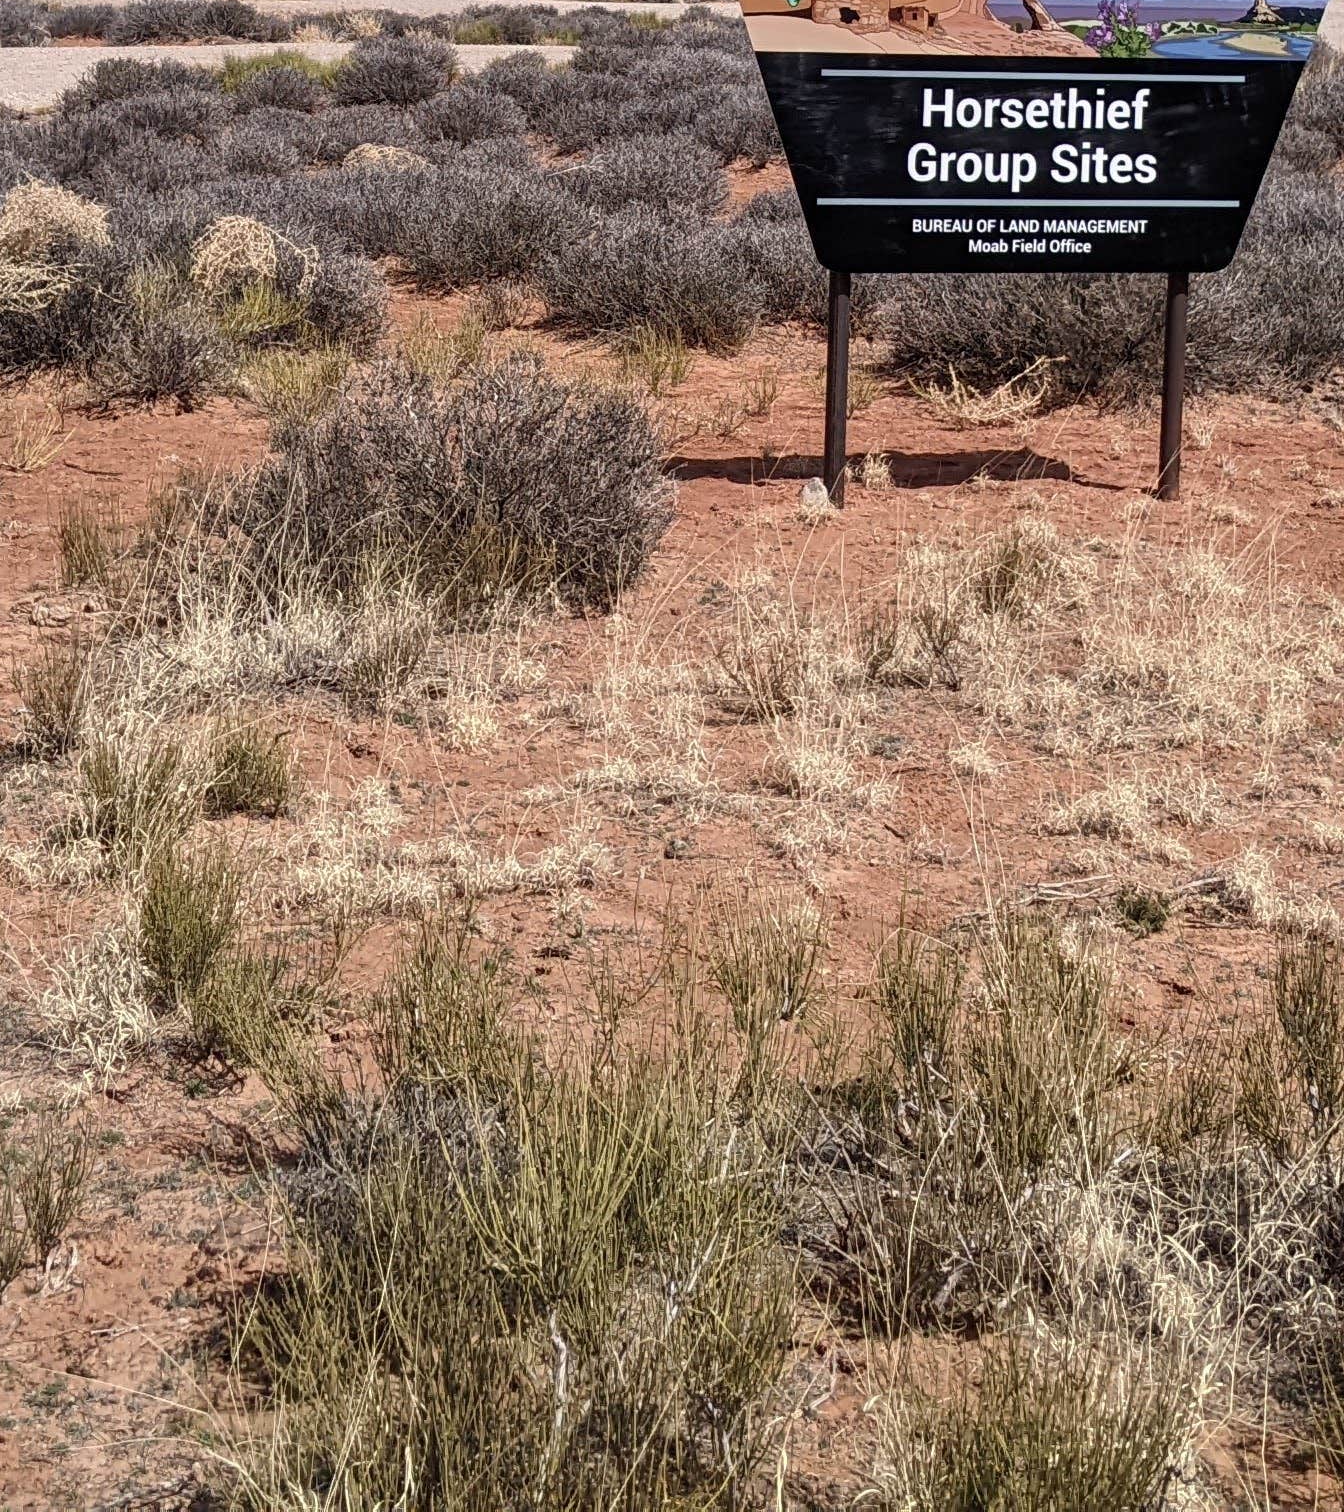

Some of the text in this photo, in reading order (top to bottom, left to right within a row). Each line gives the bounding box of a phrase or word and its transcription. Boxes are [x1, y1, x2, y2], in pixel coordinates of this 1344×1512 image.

[922, 88, 1149, 129] Horsethief
[907, 142, 1157, 192] Group Sites
[912, 218, 1149, 234] BUREAU OF LAND MANAGEMENT
[968, 238, 1092, 254] Moab Field Office
